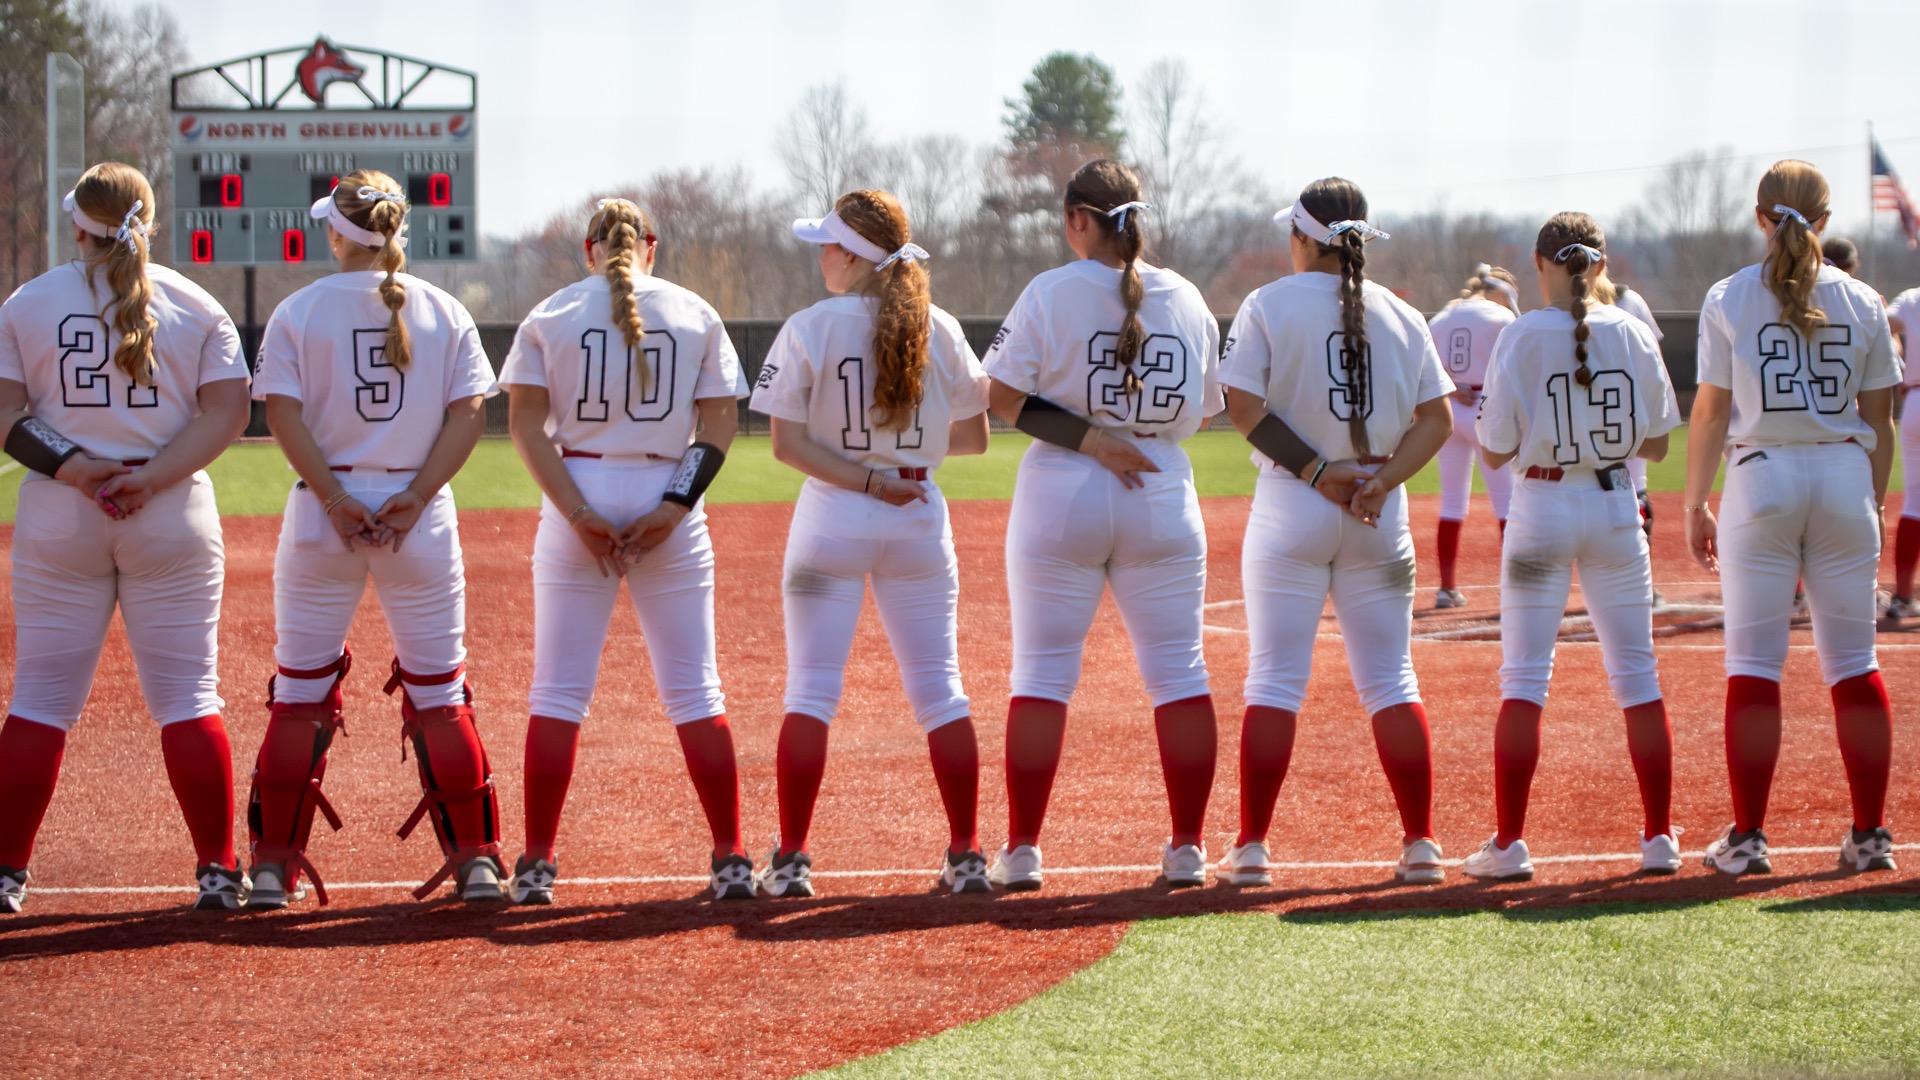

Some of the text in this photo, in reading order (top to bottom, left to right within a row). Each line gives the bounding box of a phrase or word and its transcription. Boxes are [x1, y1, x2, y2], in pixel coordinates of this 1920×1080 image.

[207, 122, 442, 138] NORTH GREENVILLE
[402, 151, 458, 171] GUESTS
[221, 174, 243, 208] 0
[429, 173, 451, 207] 0
[185, 210, 221, 230] BALL
[191, 229, 213, 263] 0
[283, 228, 305, 262] 0
[1449, 327, 1472, 373] 8
[1758, 322, 1852, 414] 25
[353, 328, 405, 422] 5
[577, 328, 677, 422] 10
[1087, 331, 1187, 424] 22
[1326, 330, 1374, 421] 9
[838, 357, 923, 451] 1
[1547, 369, 1636, 465] 13
